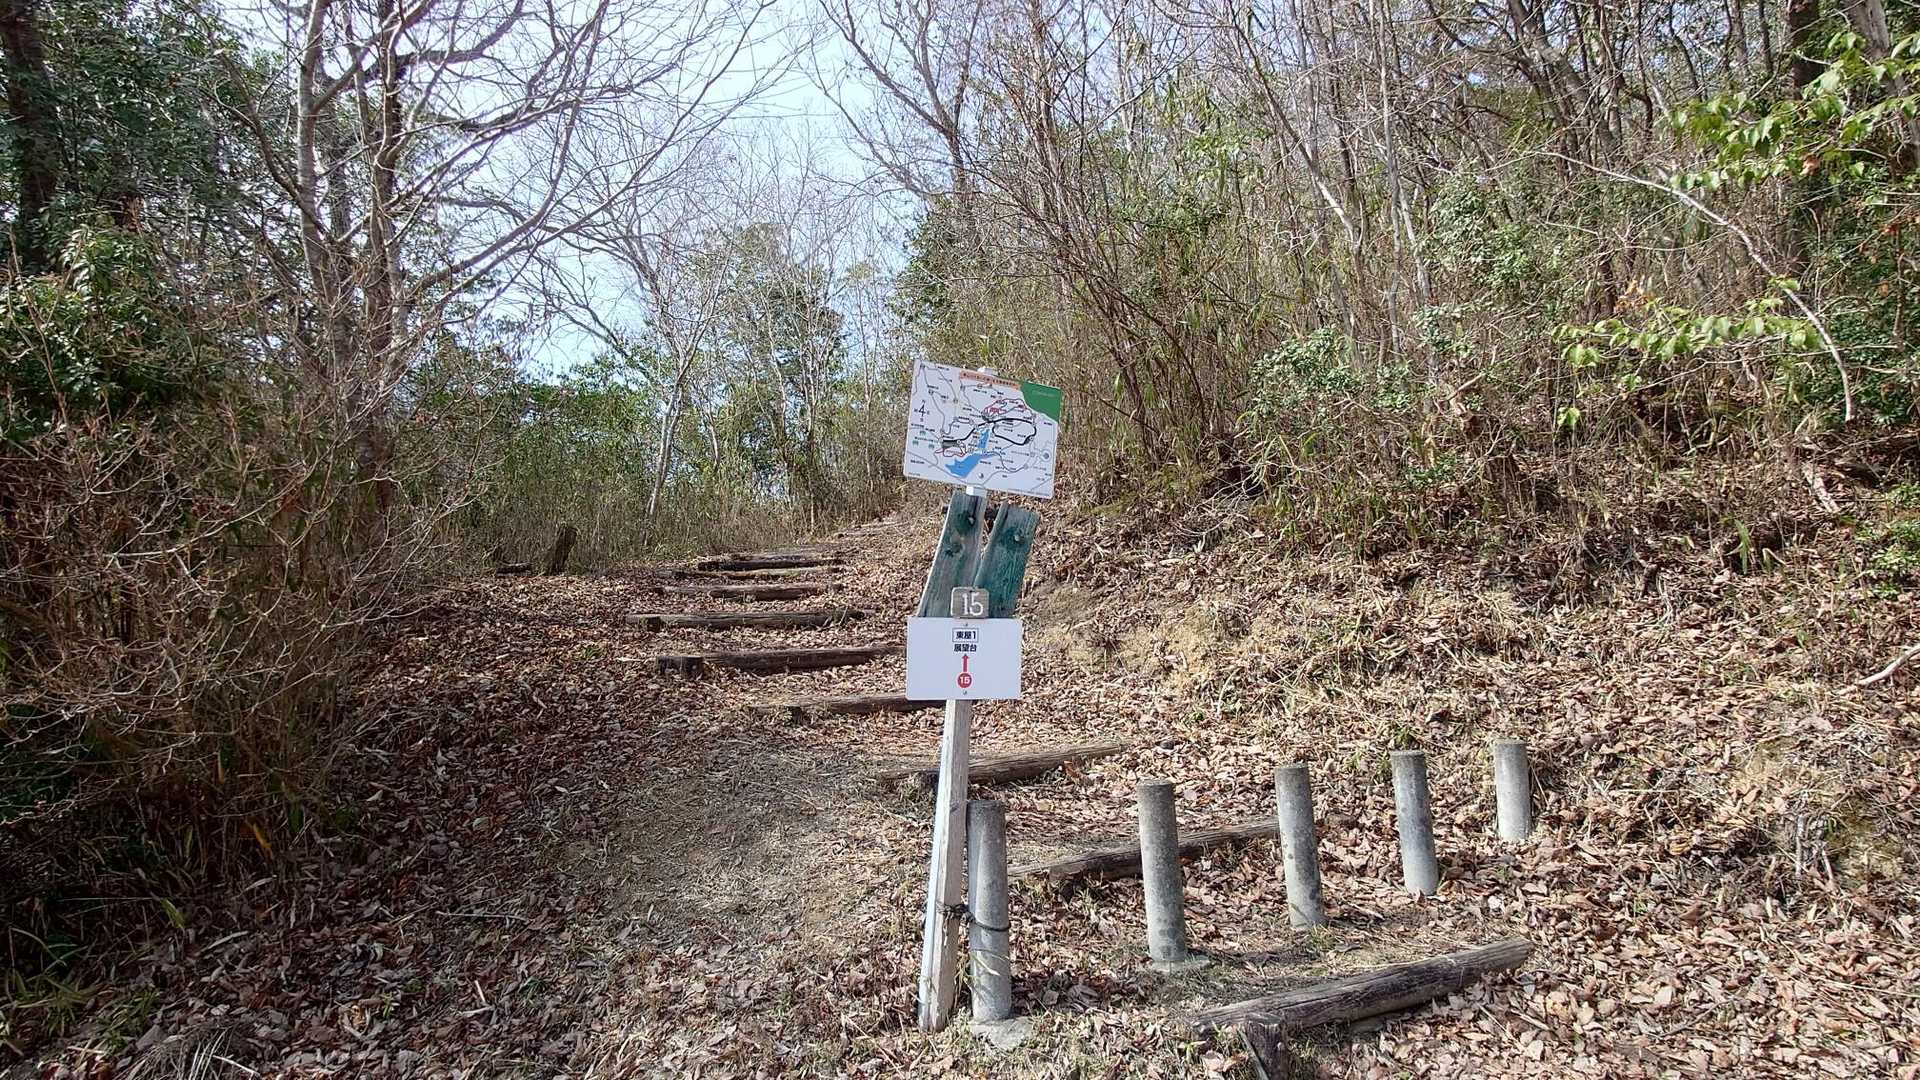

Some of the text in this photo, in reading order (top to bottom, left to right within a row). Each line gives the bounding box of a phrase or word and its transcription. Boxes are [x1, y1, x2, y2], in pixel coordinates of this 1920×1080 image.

[961, 592, 984, 616] 15
[954, 643, 977, 652] 展望台
[959, 676, 970, 684] 15
